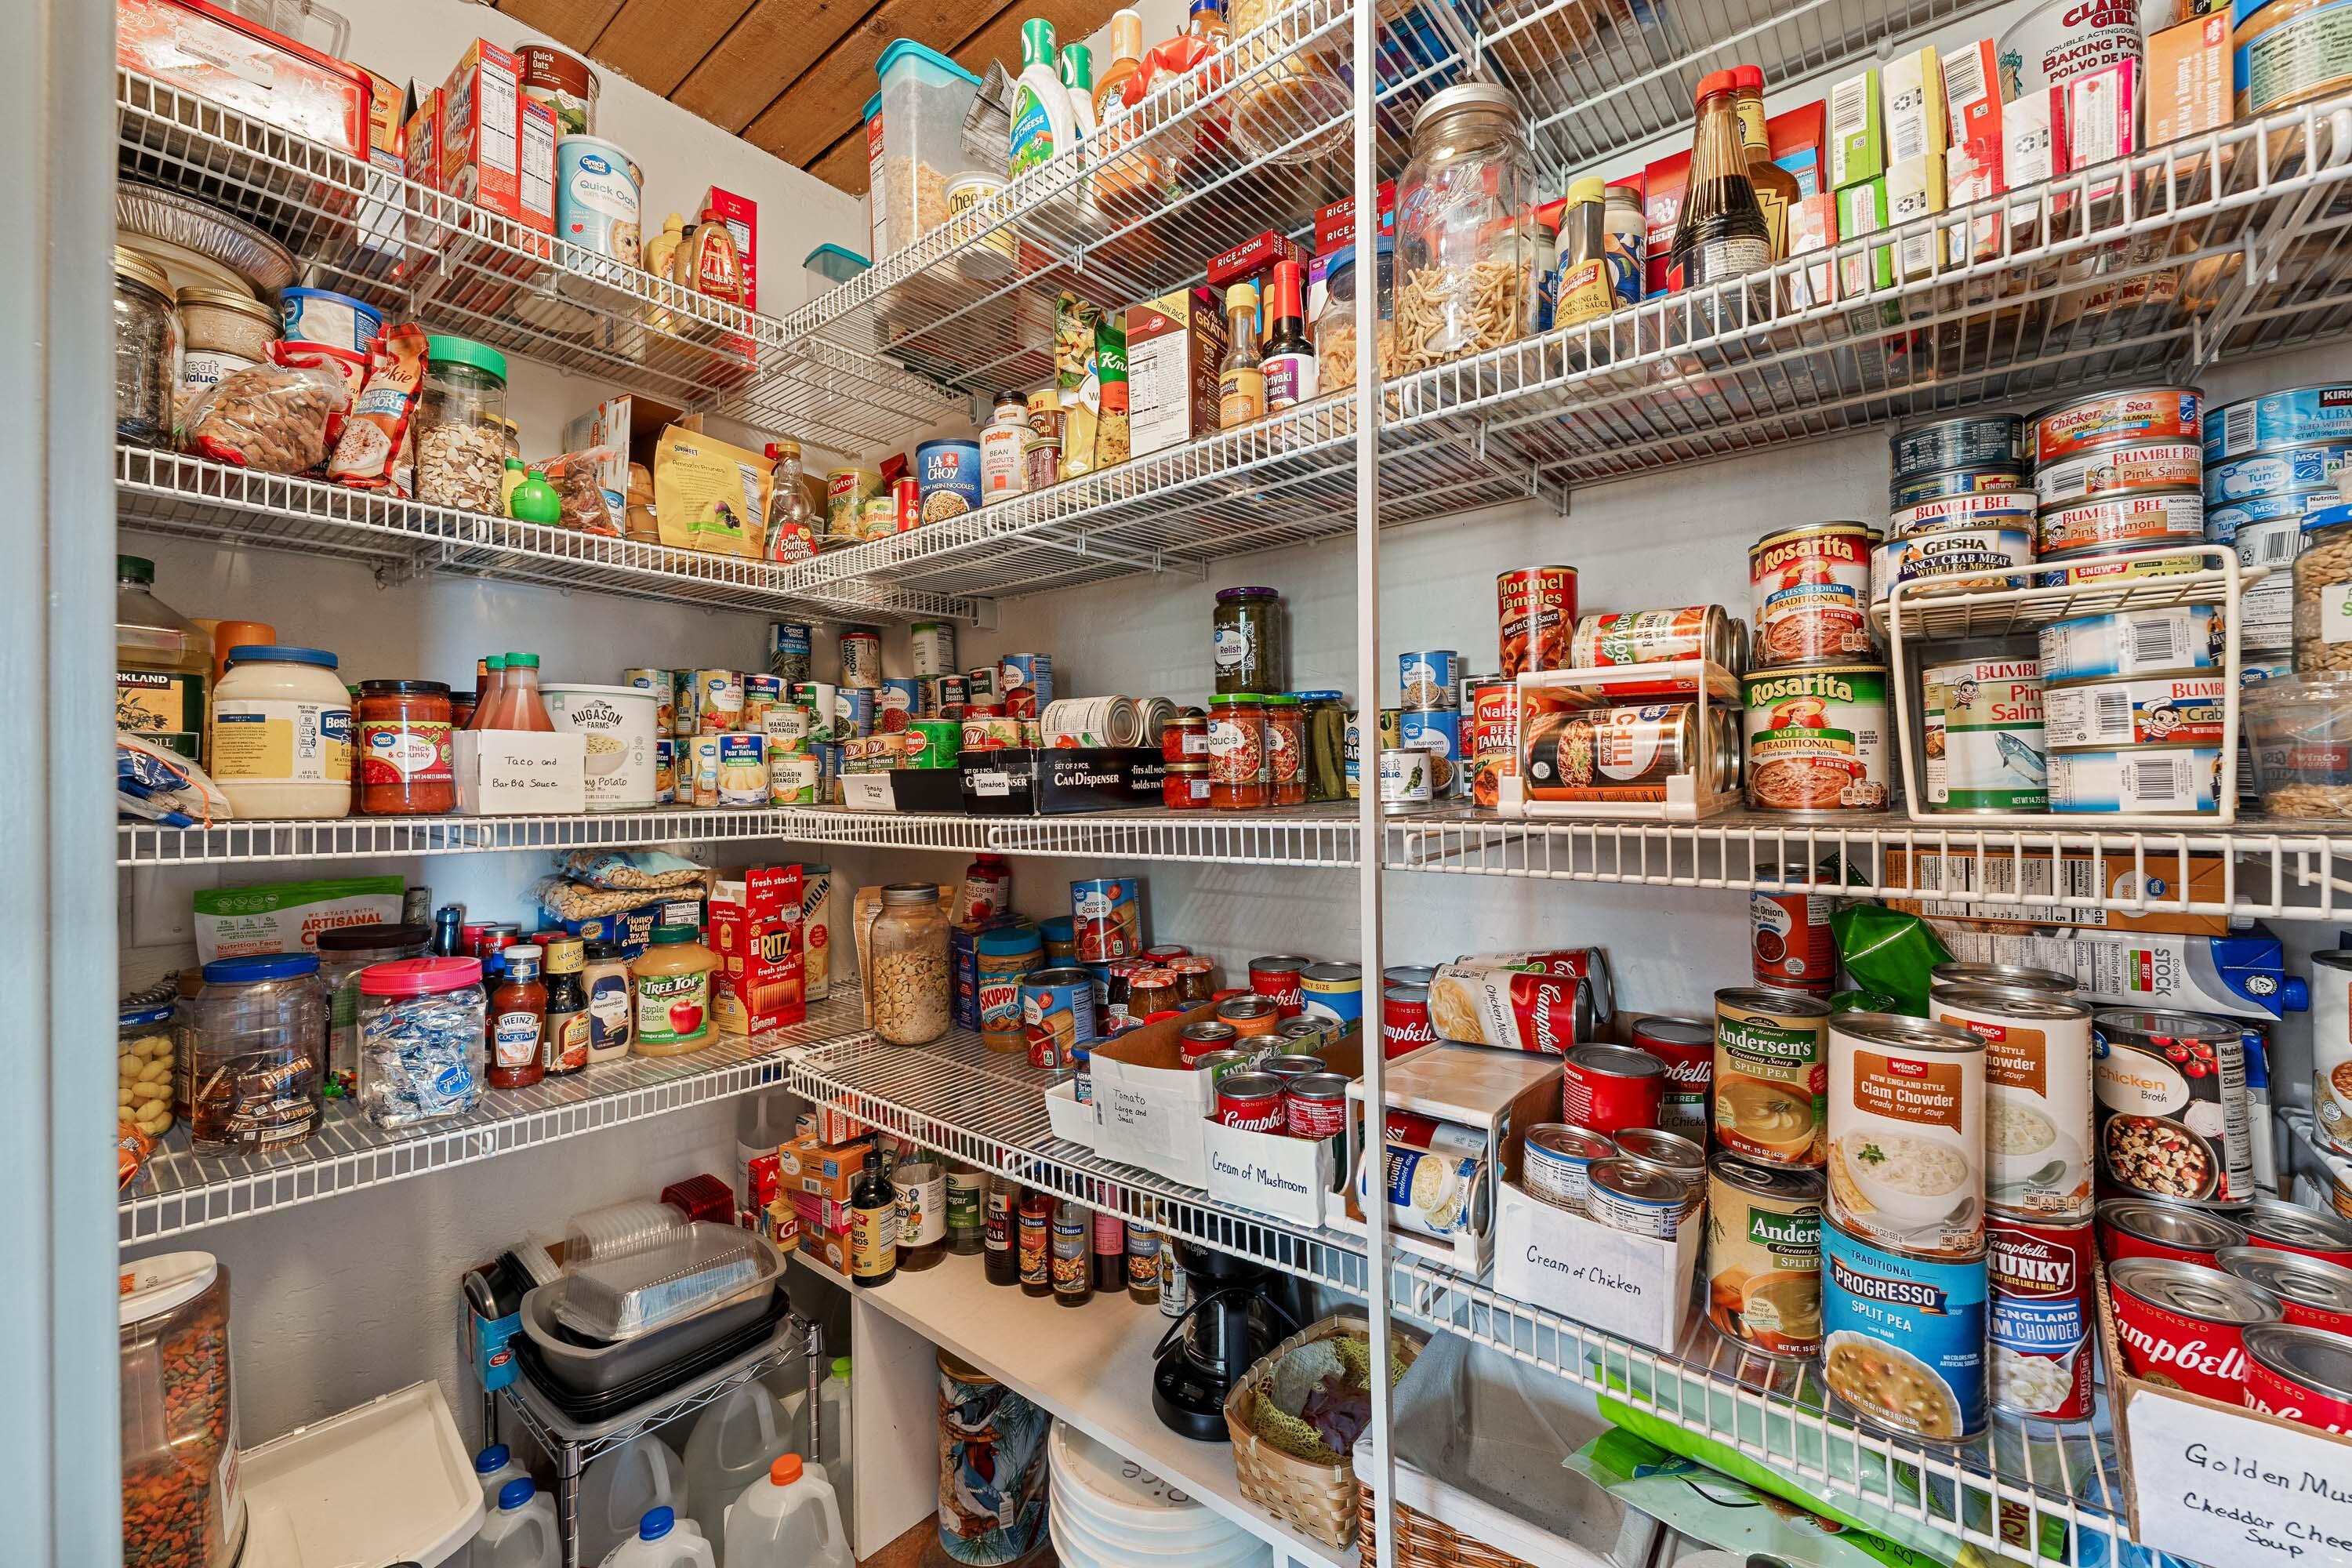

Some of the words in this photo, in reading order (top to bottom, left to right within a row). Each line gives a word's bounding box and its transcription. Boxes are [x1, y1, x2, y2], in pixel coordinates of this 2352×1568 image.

[2091, 9, 2135, 28] GIRL
[2045, 34, 2085, 56] DOUBLE
[532, 50, 554, 63] Quick
[2042, 36, 2113, 74] BAKING
[532, 60, 550, 71] Oats
[2049, 59, 2098, 84] POLVO
[2101, 54, 2119, 65] DE
[1018, 114, 1045, 138] CHEESE
[582, 157, 607, 169] Great
[579, 180, 614, 196] Quick
[615, 190, 637, 210] Oats
[1327, 201, 1350, 219] RICE
[1327, 224, 1350, 242] RICE
[1217, 251, 1237, 268] RICE
[701, 269, 735, 286] GULDEN'S
[1155, 299, 1171, 314] TWIN
[1169, 305, 1187, 322] PACK
[1584, 300, 1610, 310] SAUCE
[2049, 408, 2103, 433] Chicken
[2125, 400, 2154, 413] Sea
[2071, 423, 2092, 435] PINK
[2116, 412, 2153, 424] SALMON
[985, 430, 1014, 444] polar
[673, 443, 699, 457] SUNSWEET
[989, 448, 1010, 458] BEAN
[2113, 448, 2180, 466] BUMBLE
[927, 456, 943, 469] LA
[944, 453, 958, 467] 東
[985, 456, 1015, 467] SPROUTS
[2295, 452, 2321, 463] MSC
[927, 466, 959, 481] CHOY
[2123, 466, 2154, 480] Pink
[2157, 465, 2196, 478] Salmon
[2247, 470, 2283, 484] Tuna
[944, 483, 975, 492] NOODLES
[1915, 497, 1980, 521] BUMBLE
[2063, 503, 2131, 525] BUMBLE
[2254, 503, 2280, 514] MSC
[2070, 524, 2098, 539] Pink
[2101, 518, 2156, 535] Salmon
[780, 539, 811, 553] Butter-
[1922, 538, 1988, 556] GEISHA
[1763, 535, 1855, 574] Rosarita
[1903, 557, 1937, 575] FANCY
[1941, 554, 1976, 565] CRAB
[1977, 553, 2010, 568] MEAT
[1916, 565, 1943, 578] WITH
[1945, 564, 1967, 574] LEG
[2078, 563, 2127, 576] SNOW'S
[1499, 573, 1564, 597] Hormel
[1784, 587, 1804, 597] LESS
[1805, 585, 1844, 594] SODIUM
[1501, 590, 1563, 610] Tamales
[1774, 593, 1841, 610] TRADITIONAL
[1537, 612, 1559, 623] Sauce
[1824, 612, 1854, 621] FIBER
[783, 626, 804, 635] Great
[1220, 645, 1242, 655] Relish
[849, 639, 858, 677] HOMINY
[946, 685, 964, 695] Black
[1751, 673, 1855, 708] Rosarita
[945, 693, 965, 702] Beans
[571, 708, 624, 726] AUGASON
[586, 720, 610, 729] FARMS
[768, 720, 800, 729] MANDARIN
[769, 726, 799, 735] ORANGES
[1613, 713, 1637, 766] CHILI
[1773, 729, 1791, 739] NO
[1793, 727, 1821, 739] FAT
[1209, 735, 1238, 746] Sauce
[1759, 738, 1836, 752] TRADITIONAL
[395, 750, 431, 760] Chunky
[407, 743, 430, 753] Thick
[724, 749, 738, 757] Pear
[738, 748, 759, 757] Halves
[504, 755, 534, 766] Taco
[541, 757, 557, 766] and
[2296, 751, 2340, 764] WinCo
[1815, 760, 1851, 771] FIBER
[492, 778, 510, 788] Bar
[529, 779, 559, 789] Sauce
[597, 777, 627, 786] Potato
[772, 776, 800, 785] ORANGES
[977, 778, 1007, 789] Tomatoes
[863, 783, 883, 793] Tomato
[751, 877, 772, 888] fresh
[773, 874, 797, 885] stacks
[1081, 905, 1107, 915] Sauce
[1083, 899, 1107, 908] Tomato
[324, 909, 351, 917] START
[353, 906, 375, 915] WITH
[300, 912, 383, 931] ARTISANAL
[627, 914, 654, 927] Honey
[629, 922, 651, 933] Maid
[216, 942, 258, 952] Nutrition
[259, 939, 283, 949] Facts
[760, 931, 793, 961] RITZ
[757, 965, 775, 977] fresh
[775, 961, 797, 973] stacks
[2141, 962, 2151, 981] BEEF
[2154, 947, 2172, 997] STOCK
[2172, 956, 2181, 990] COOKING
[645, 980, 672, 996] TREE
[673, 975, 699, 990] TOP
[593, 998, 624, 1011] Horseradish
[979, 986, 1017, 1011] SKIPPY
[641, 1004, 665, 1017] Apple
[641, 1012, 665, 1022] Sauce
[503, 1015, 533, 1027] HEINZ
[498, 1031, 536, 1041] COCKTAIL
[1970, 1024, 2002, 1038] WinCo
[1718, 1022, 1813, 1057] Andersen's
[1730, 1048, 1766, 1064] Creamy
[1767, 1056, 1794, 1067] Soup
[2006, 1046, 2027, 1056] STYLE
[261, 1056, 314, 1090] HEATH
[1734, 1060, 1763, 1075] SPLIT
[1767, 1068, 1789, 1079] PEA
[1891, 1061, 1923, 1073] WinCo
[1869, 1073, 1886, 1082] NEW
[1886, 1075, 1922, 1090] ENGLAND
[1922, 1083, 1946, 1092] STYLE
[2096, 1065, 2167, 1091] Chicken
[1112, 1088, 1146, 1105] Tomato
[1673, 1094, 1697, 1103] FREE
[1860, 1080, 1893, 1099] Clam
[1896, 1088, 1955, 1107] Chowder
[2140, 1087, 2169, 1102] Broth
[1114, 1105, 1133, 1116] Large
[1134, 1109, 1147, 1117] and
[1869, 1098, 1893, 1112] ready
[1896, 1103, 1906, 1112] to
[1907, 1106, 1922, 1115] eat
[1923, 1109, 1945, 1120] soup
[1117, 1114, 1134, 1125] Small
[1212, 1152, 1239, 1178] Cream
[1241, 1163, 1254, 1181] of
[1256, 1168, 1308, 1195] Mushroom
[1388, 1156, 1404, 1189] Noodle
[1024, 1218, 1044, 1228] House
[1189, 1243, 1209, 1256] Coffee
[1776, 1244, 1813, 1256] Creamy
[1780, 1257, 1811, 1268] SPLIT
[1851, 1250, 1913, 1279] TRADITIONAL
[1526, 1245, 1570, 1275] Cream
[1573, 1265, 1585, 1278] of
[1588, 1267, 1642, 1296] Chicken
[1835, 1265, 1936, 1307] PROGRESSO
[1851, 1300, 1883, 1323] SPLIT
[1886, 1314, 1912, 1333] PEA
[1995, 1307, 2078, 1324] ENGLAND
[2122, 1294, 2209, 1334] CONDENSED
[2016, 1320, 2082, 1341] CHOWDER
[2184, 1442, 2290, 1490] Golden
[2299, 1472, 2352, 1504] Mus
[2183, 1491, 2274, 1530] Cheddar
[2284, 1521, 2352, 1552] Chee
[2245, 1529, 2306, 1559] Soup
